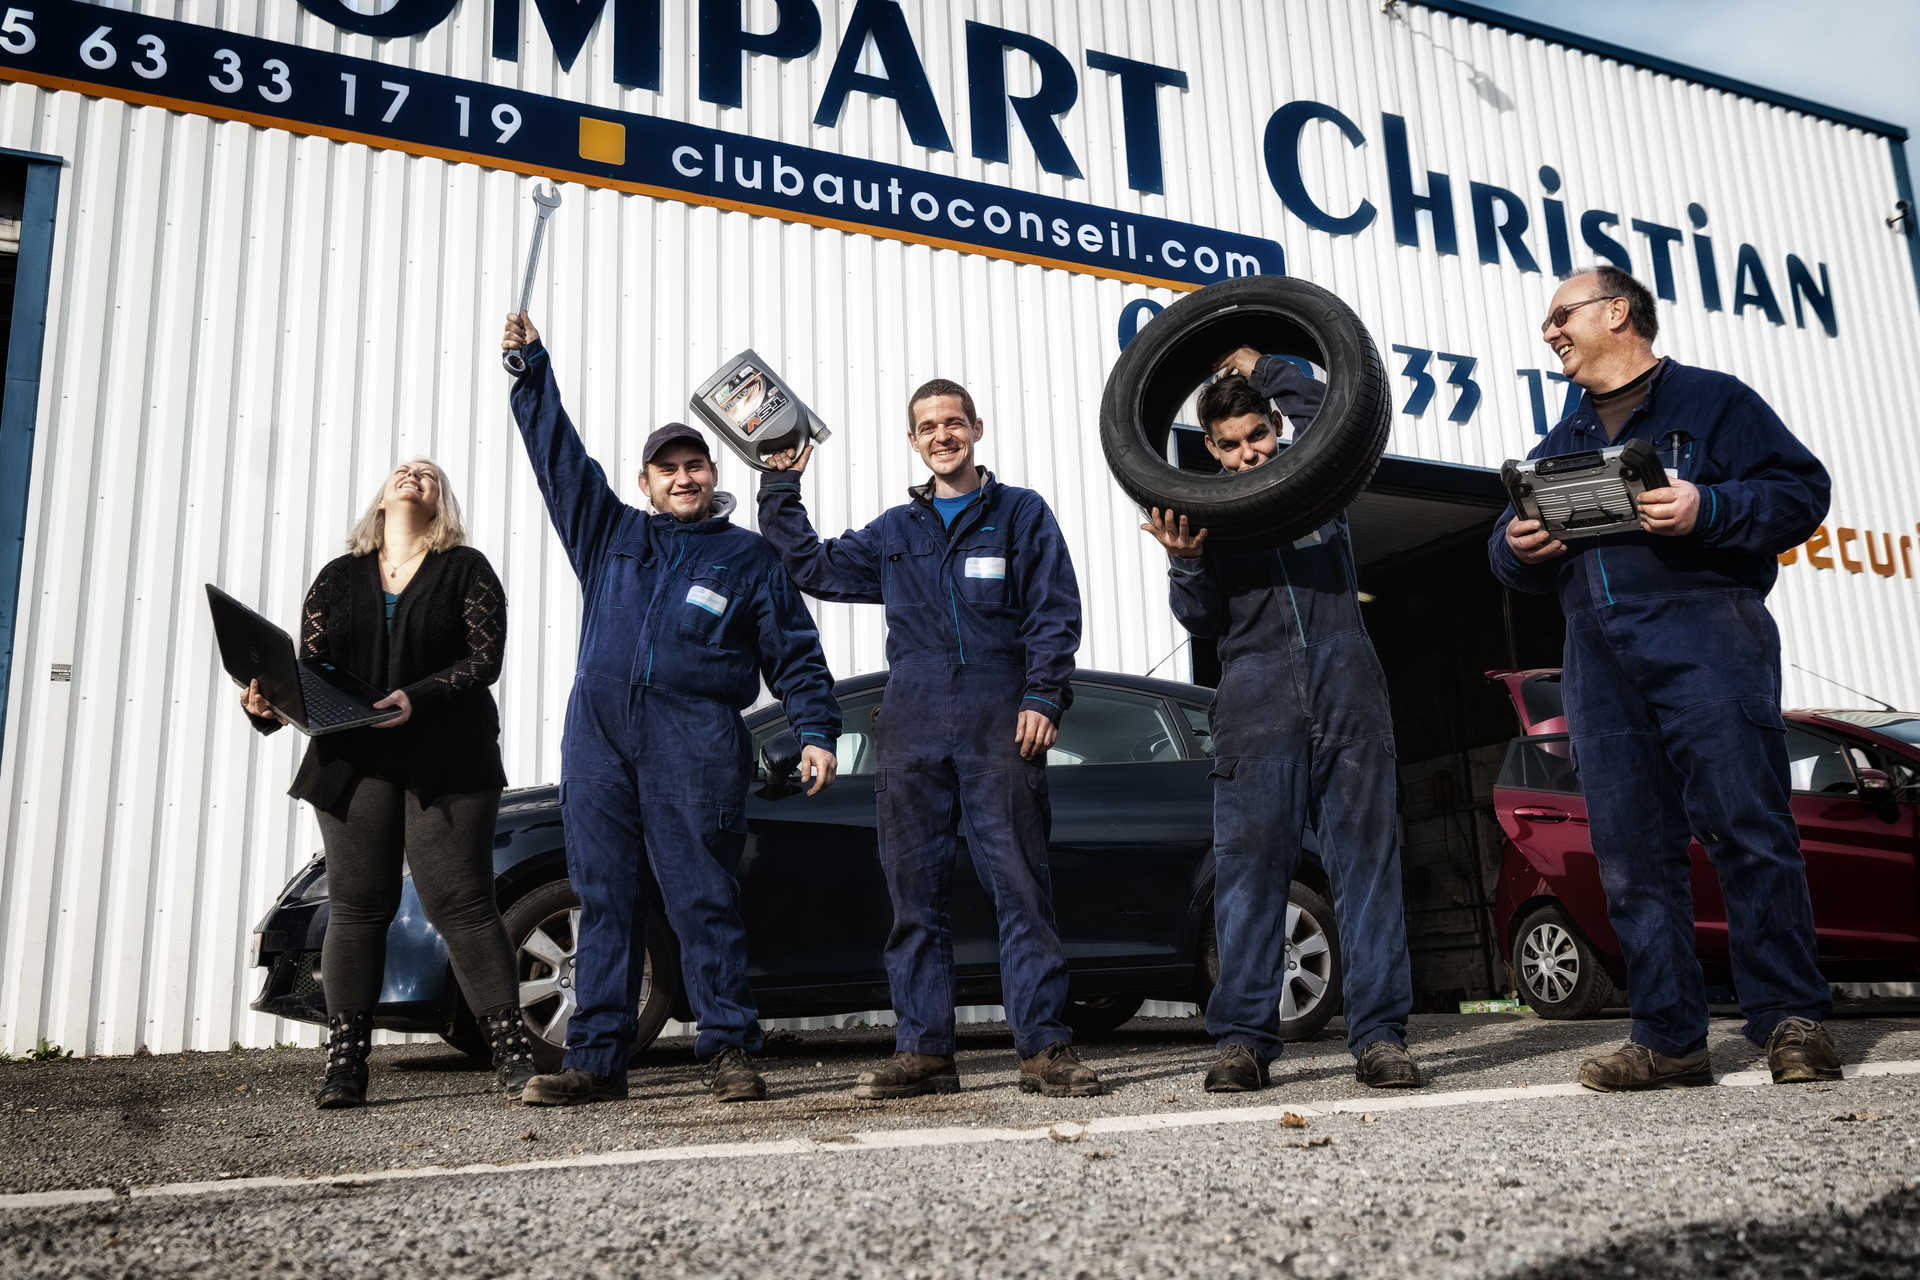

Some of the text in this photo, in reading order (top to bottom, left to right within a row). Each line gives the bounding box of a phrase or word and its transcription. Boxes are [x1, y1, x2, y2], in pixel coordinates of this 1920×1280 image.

[80, 26, 168, 79] 63
[208, 48, 292, 103] 33
[341, 72, 410, 123] 17
[455, 95, 522, 144] 19
[672, 143, 1262, 278] clubautoconseil.com
[300, 0, 1188, 195] MPART
[1392, 343, 1481, 423] 33
